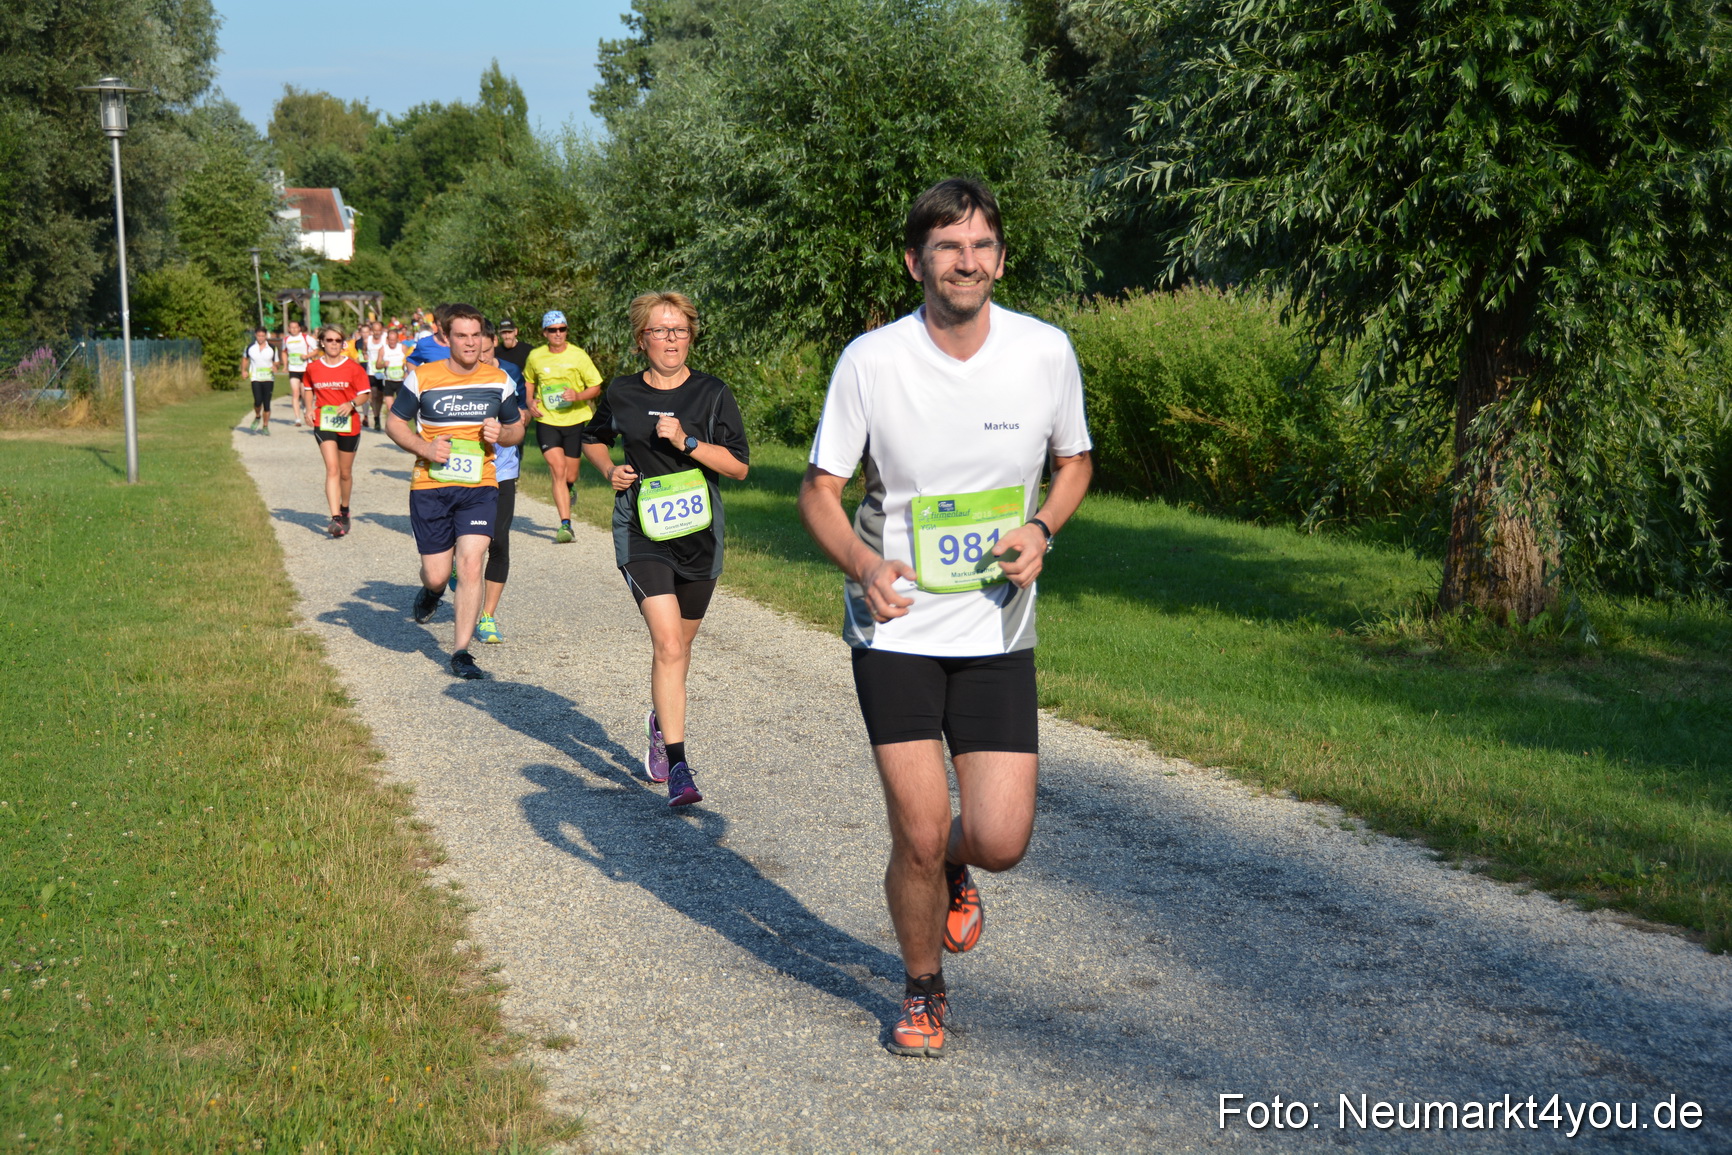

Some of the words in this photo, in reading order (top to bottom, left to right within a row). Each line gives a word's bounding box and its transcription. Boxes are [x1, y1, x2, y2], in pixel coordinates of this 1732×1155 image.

[443, 398, 490, 412] Fischer
[984, 421, 1020, 431] Markus
[440, 457, 473, 473] 433
[647, 494, 704, 524] 1238
